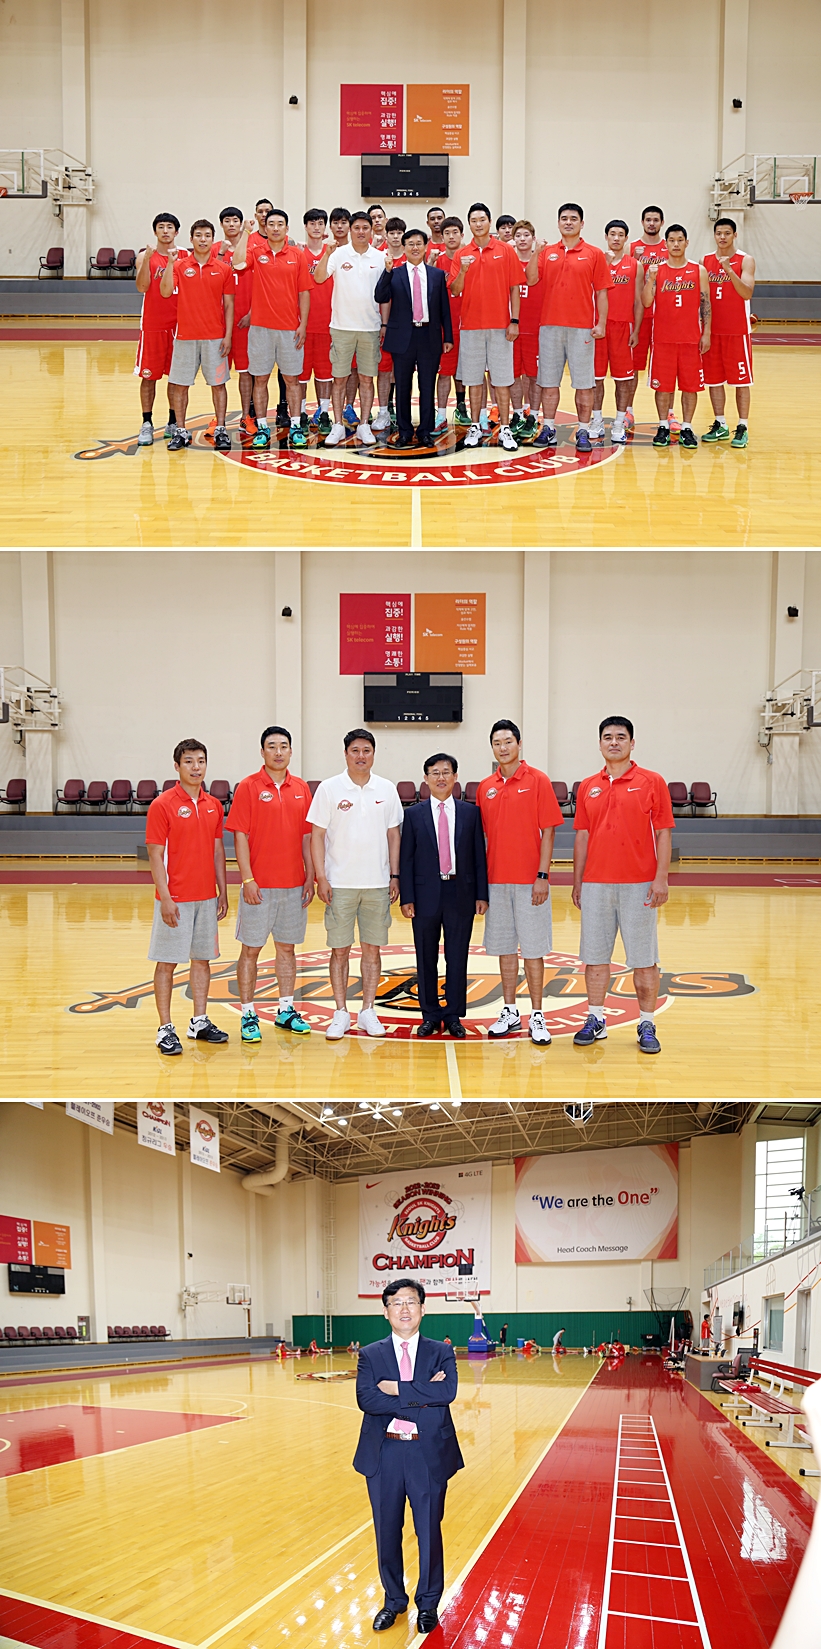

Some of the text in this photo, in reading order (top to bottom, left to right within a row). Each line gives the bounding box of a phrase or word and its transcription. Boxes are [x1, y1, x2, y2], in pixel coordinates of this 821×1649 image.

[380, 97, 397, 106] 집중!
[380, 119, 397, 128] 실행!
[380, 141, 396, 149] 소통!
[661, 280, 695, 292] Knights
[716, 287, 722, 299] 5
[675, 295, 682, 307] 3
[738, 362, 746, 374] 5
[699, 369, 704, 382] 3
[246, 452, 580, 482] BASKETBALL CLUB
[385, 608, 403, 618] 집중!
[385, 633, 403, 643] 실행!
[384, 658, 403, 667] 소통!
[567, 1197, 588, 1208] are
[592, 1194, 614, 1206] the
[387, 1213, 457, 1242] Knights
[404, 1237, 430, 1249] BASKETBALL
[372, 1248, 474, 1271] CHAMPION
